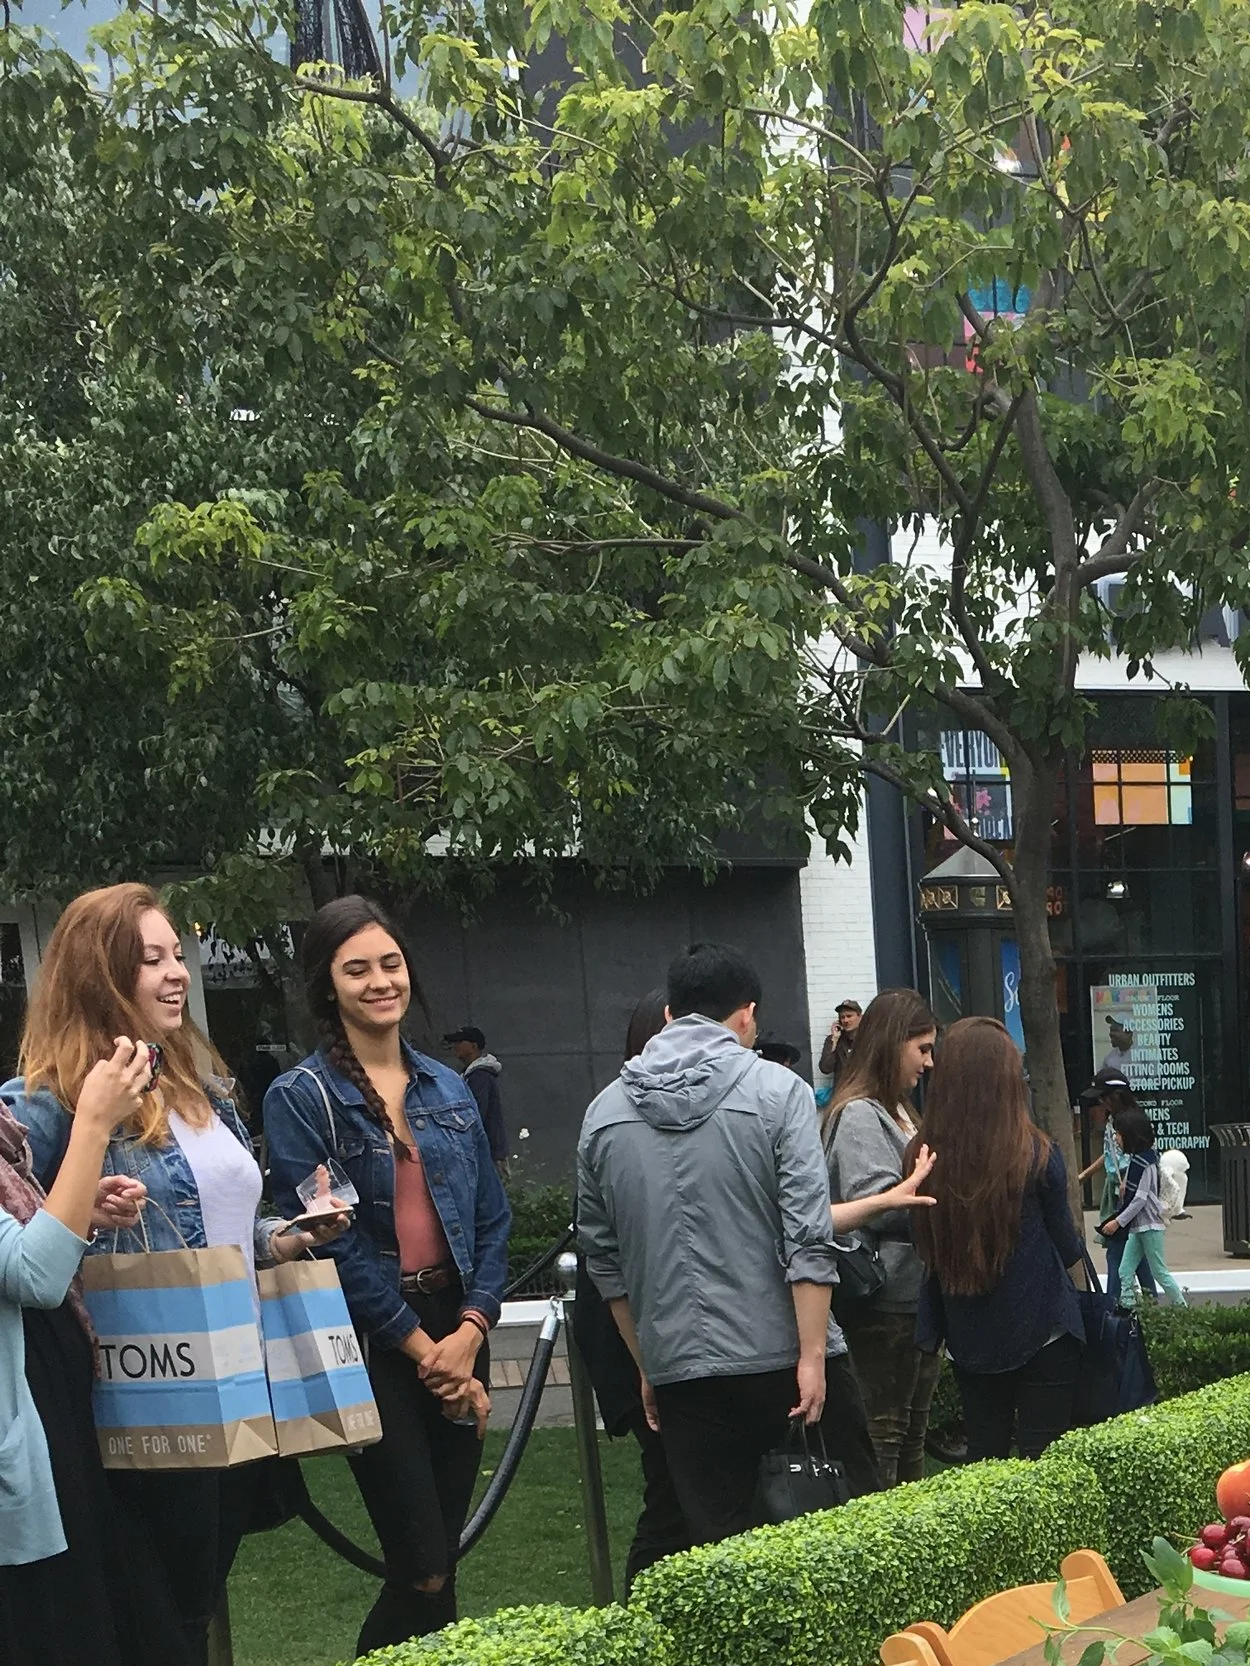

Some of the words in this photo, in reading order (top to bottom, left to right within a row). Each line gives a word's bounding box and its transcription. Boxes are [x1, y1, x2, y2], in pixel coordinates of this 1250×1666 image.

[1108, 973, 1140, 988] URBAN
[1141, 972, 1196, 987] OUTFITTERS
[1132, 1003, 1174, 1017] WOMENS
[1122, 1018, 1185, 1032] ACCESSORIES
[1137, 1033, 1172, 1047] BEAUTY
[1131, 1047, 1179, 1062] INTIMATES
[1120, 1063, 1158, 1077] FITTING
[1159, 1062, 1191, 1076] ROOMS
[1161, 1076, 1196, 1091] PICKUP
[1166, 1122, 1190, 1135] TECH
[1154, 1135, 1211, 1150] OTOGRAPHY
[328, 1333, 359, 1366] TOMS
[99, 1341, 196, 1380] TOMS
[108, 1436, 134, 1456] ONE
[141, 1435, 171, 1455] FOR
